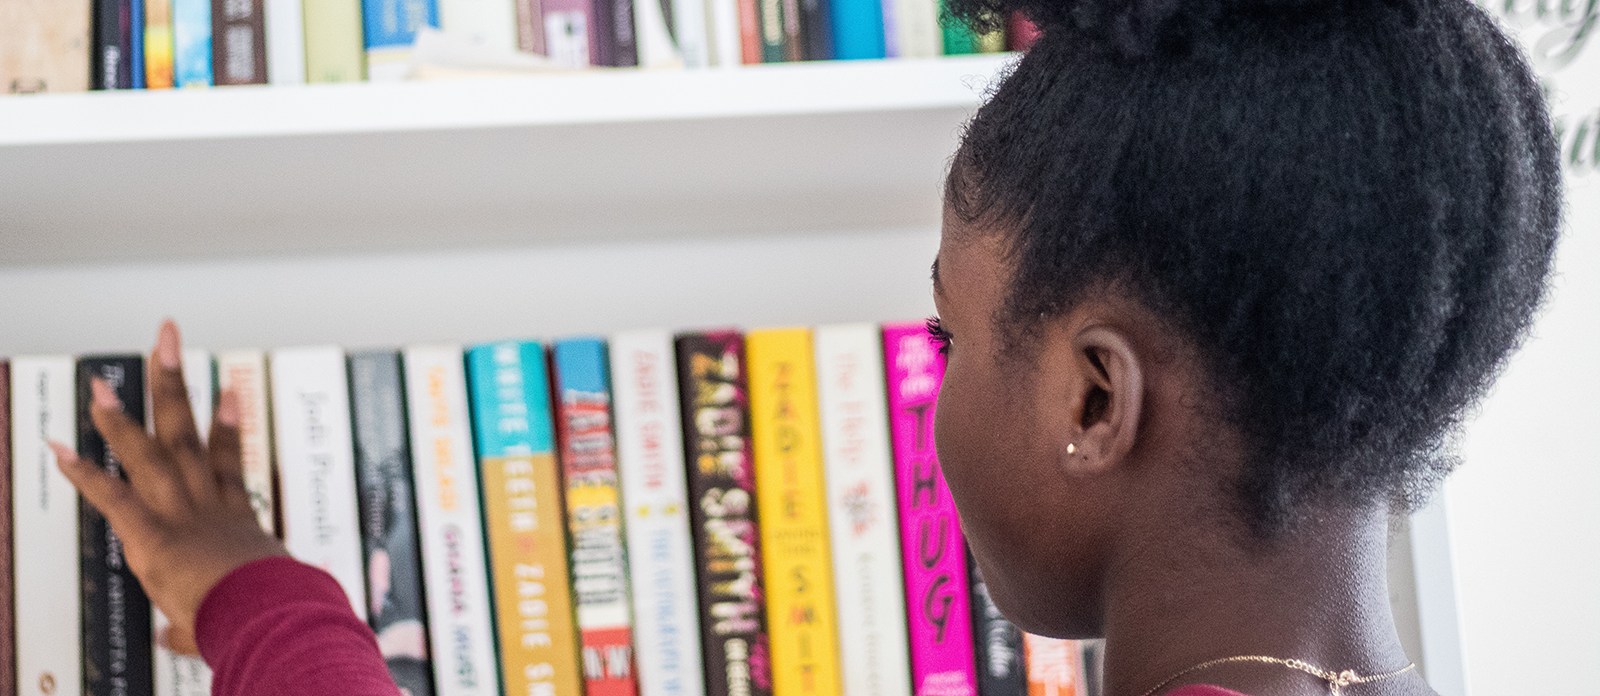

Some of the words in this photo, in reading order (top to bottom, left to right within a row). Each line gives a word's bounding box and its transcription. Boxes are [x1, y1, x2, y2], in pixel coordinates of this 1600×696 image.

[493, 344, 530, 434] WHITE
[632, 350, 662, 414] ZADIE
[691, 351, 748, 482] ZADIE
[563, 389, 617, 489] ZADIE
[639, 420, 666, 492] SMITH
[773, 360, 807, 519] ZADIE
[837, 399, 867, 466] Help
[502, 442, 539, 533] TEETH
[904, 402, 955, 645] THUG
[566, 503, 626, 608] SMITH
[701, 487, 761, 635] SMITH
[513, 562, 553, 648] ZADIE
